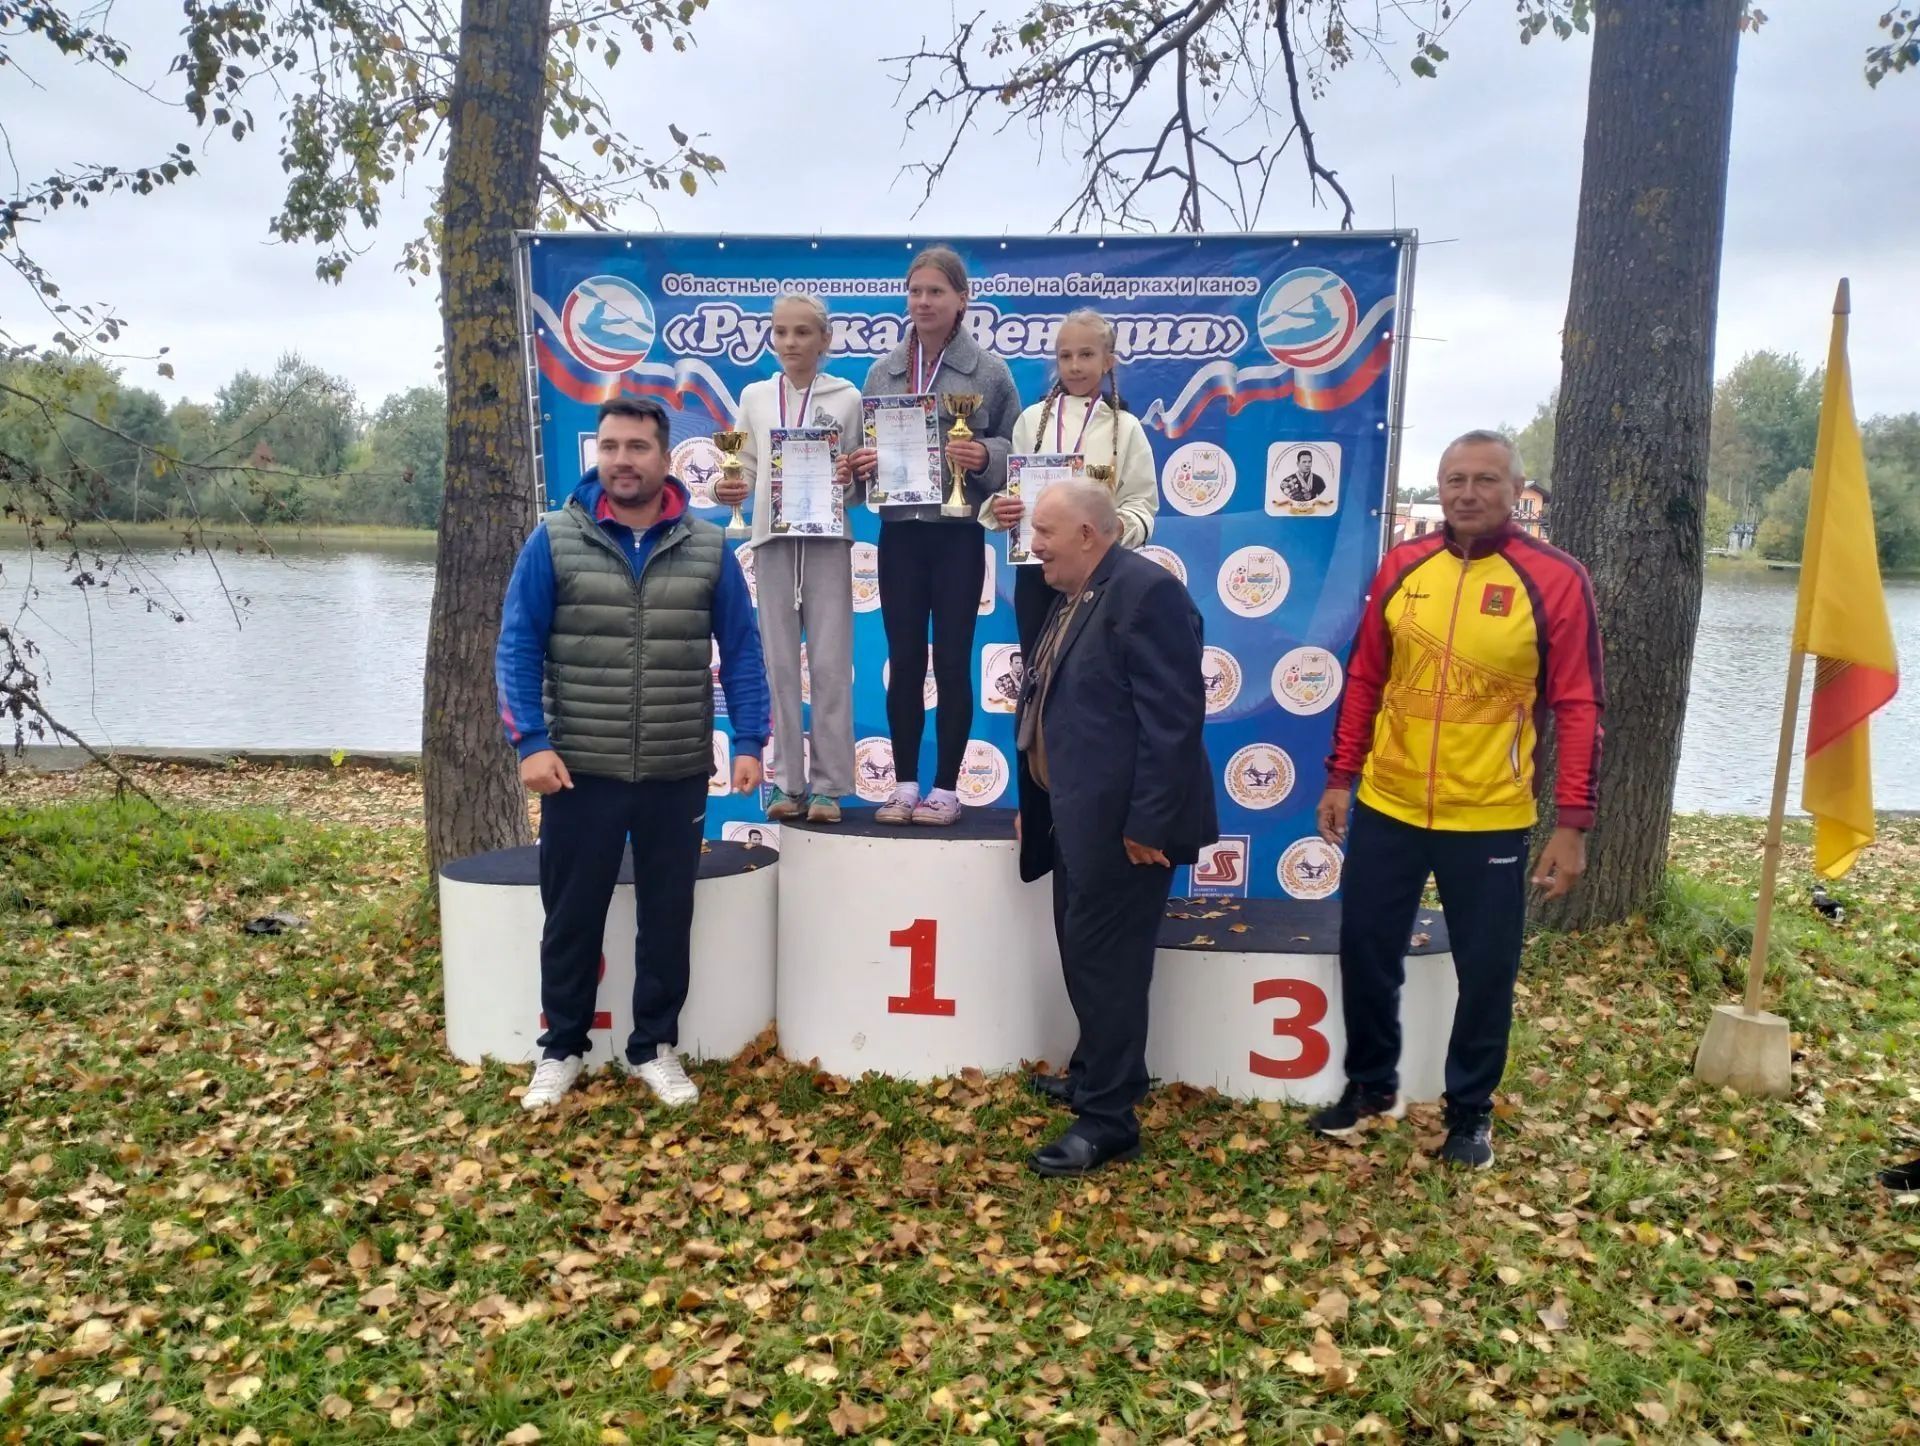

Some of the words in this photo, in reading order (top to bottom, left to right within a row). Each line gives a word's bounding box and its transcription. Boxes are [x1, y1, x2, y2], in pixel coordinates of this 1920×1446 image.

[664, 275, 777, 295] Областные
[968, 276, 1031, 299] ребле
[1037, 279, 1060, 293] на
[1066, 274, 1174, 298] байдарках
[1180, 279, 1193, 293] и
[1200, 279, 1257, 293] каноэ
[962, 305, 1245, 360] Венция»
[887, 918, 956, 1016] 1
[1250, 978, 1331, 1080] 3
